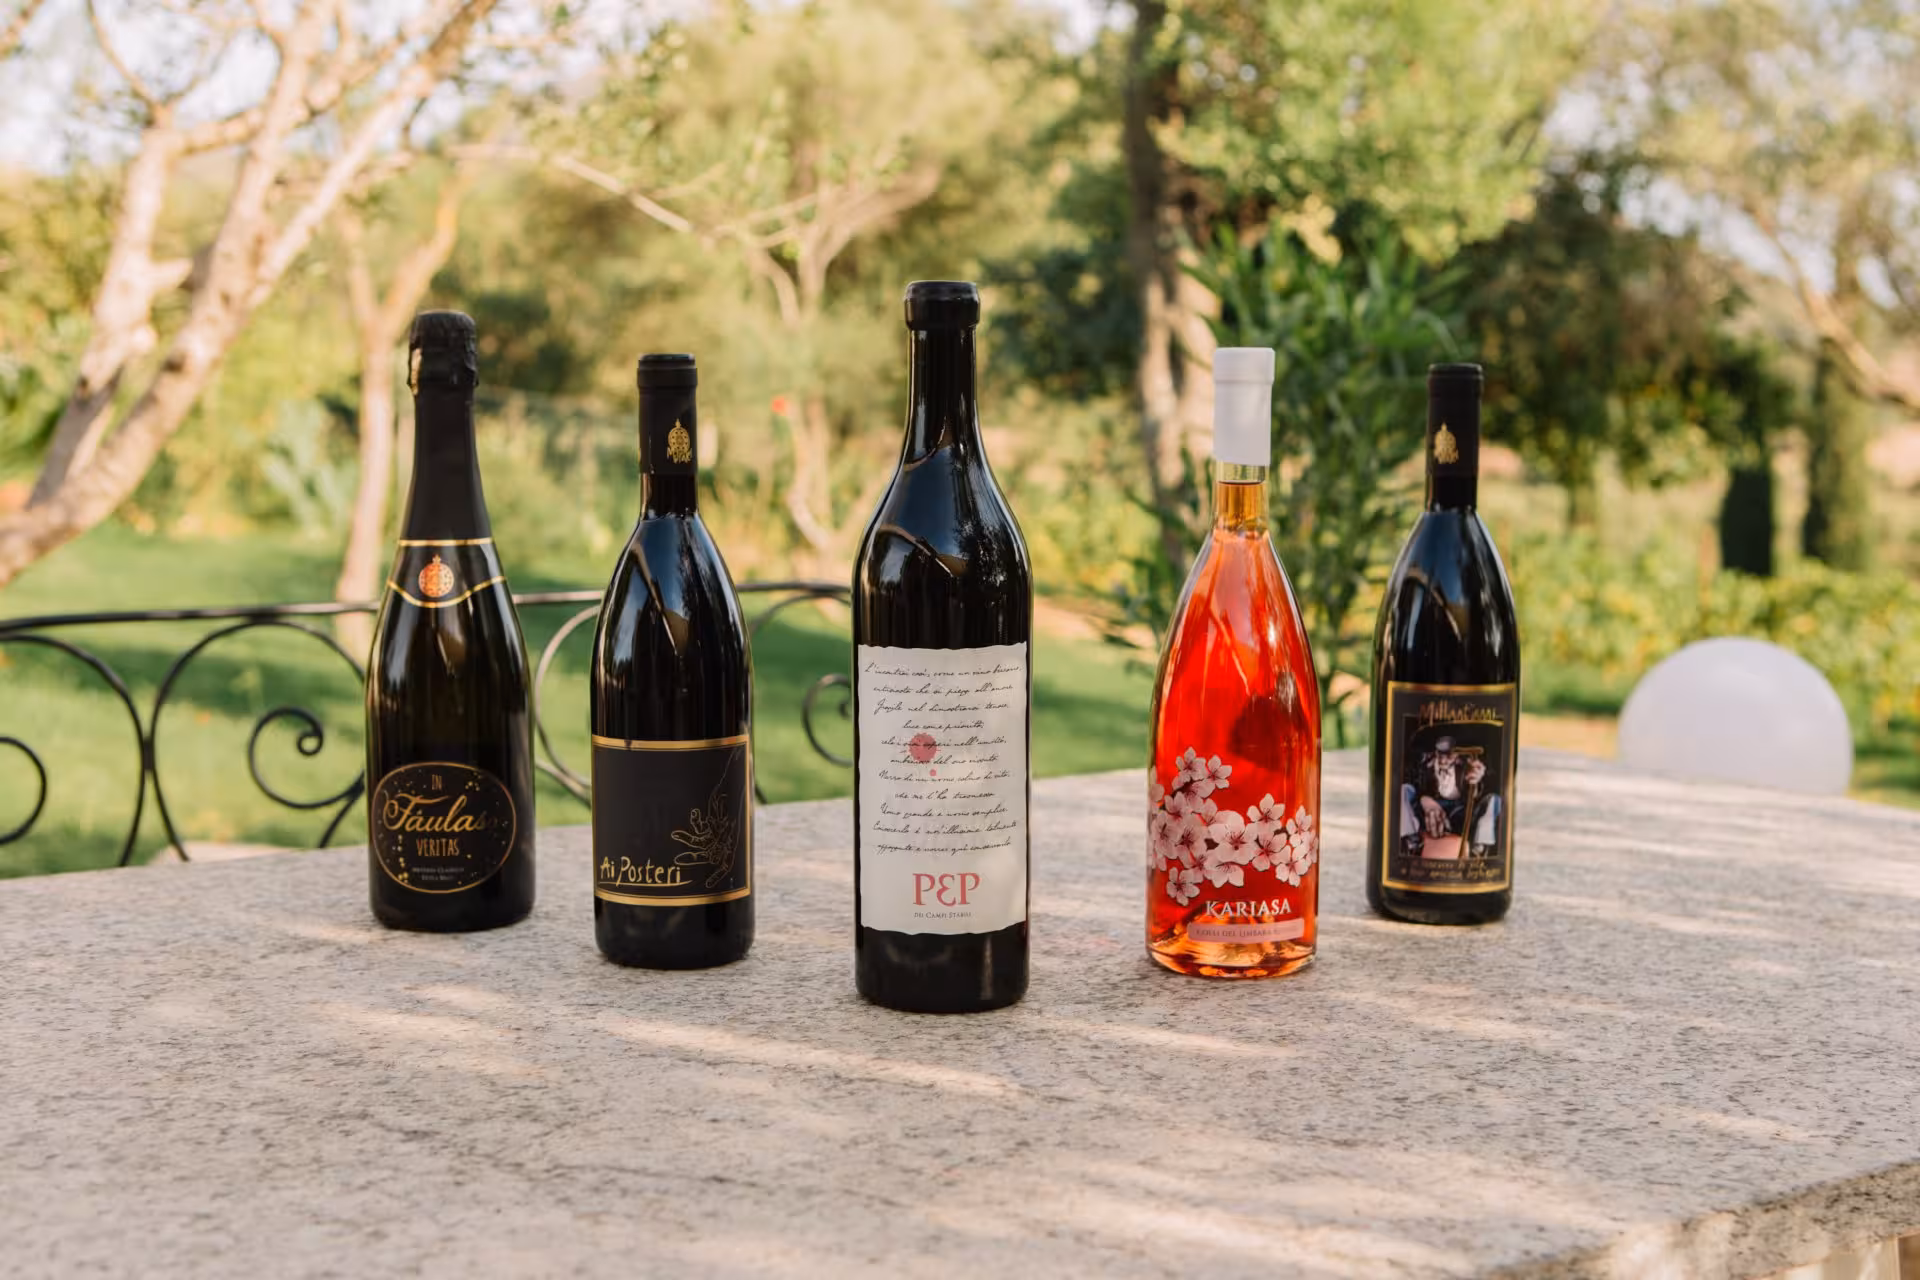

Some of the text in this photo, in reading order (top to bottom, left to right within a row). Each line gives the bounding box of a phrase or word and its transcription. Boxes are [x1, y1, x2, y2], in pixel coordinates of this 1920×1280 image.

[431, 774, 443, 790] IN
[416, 838, 460, 856] VERITAS
[600, 856, 681, 887] Ai Posteri
[1205, 897, 1291, 921] KARIASA
